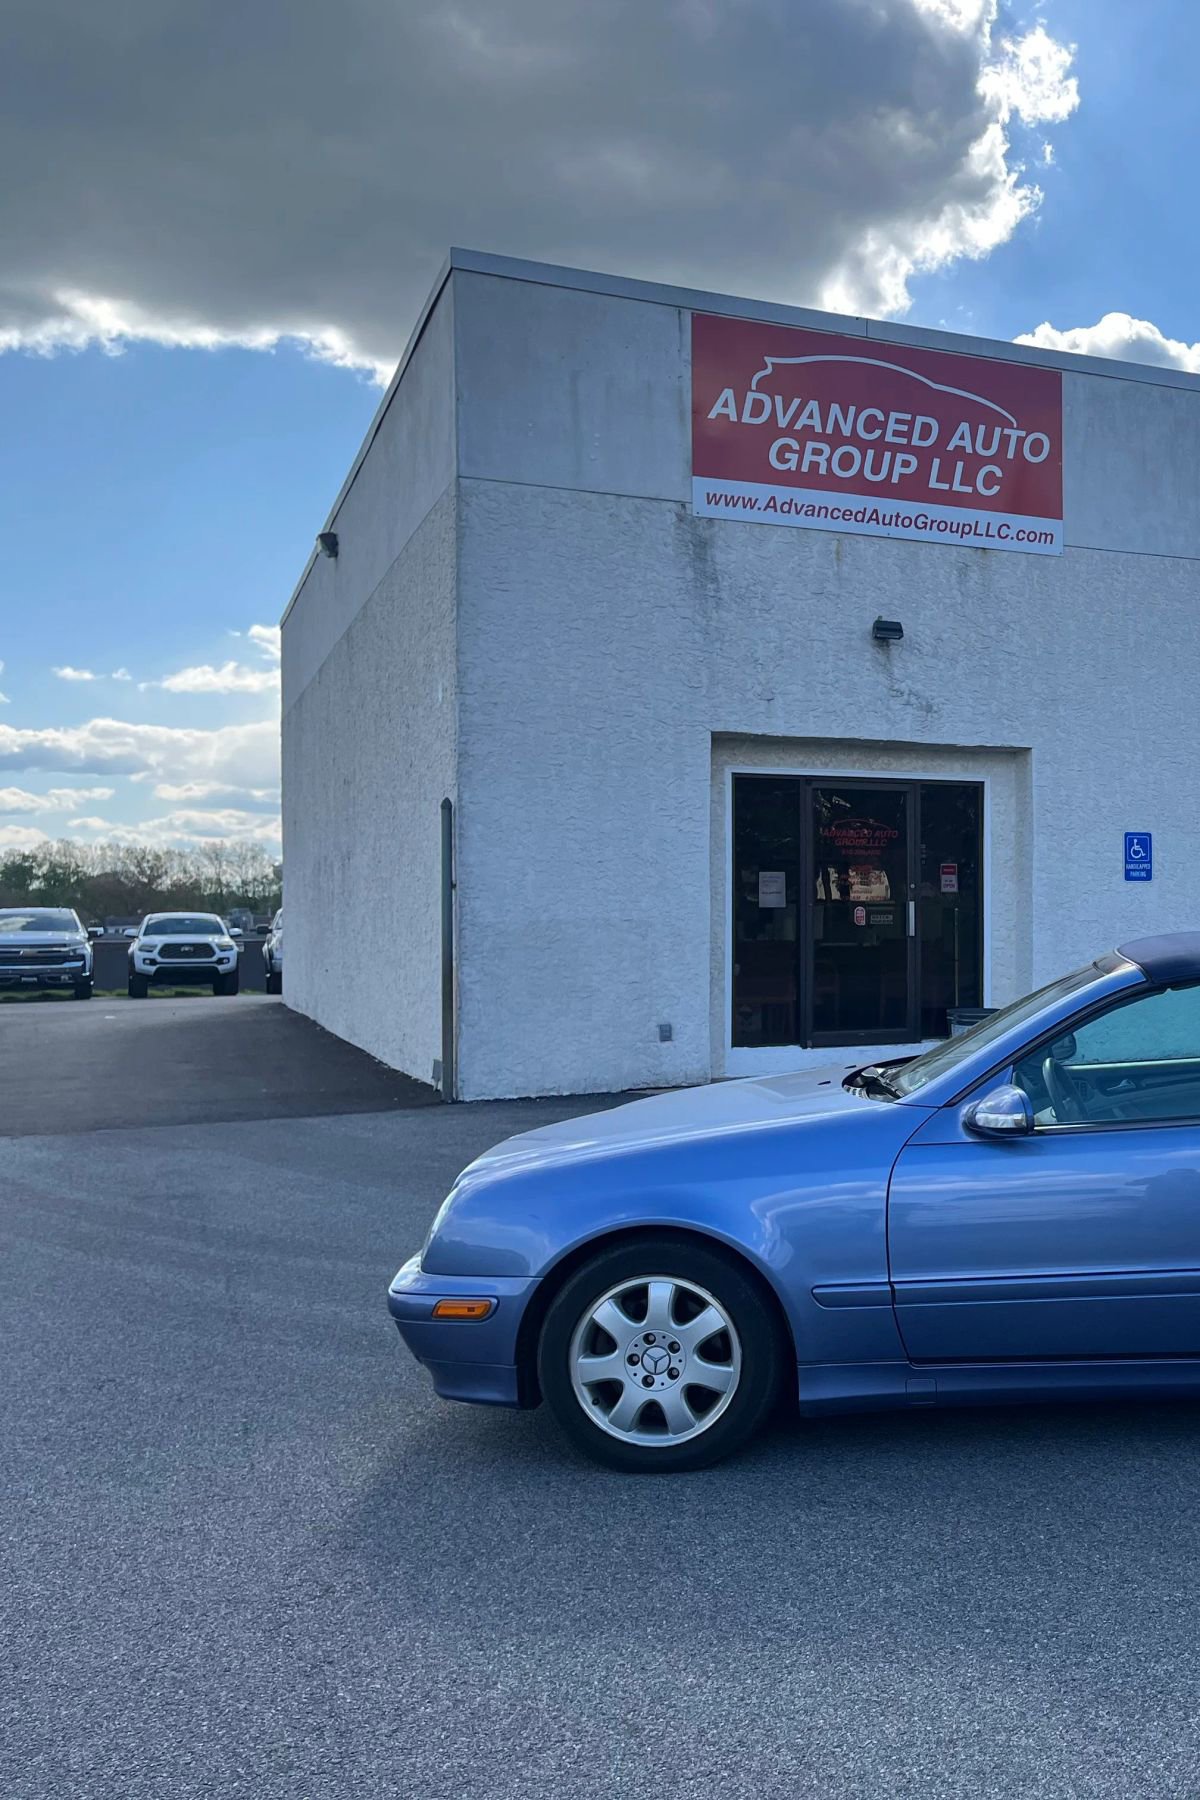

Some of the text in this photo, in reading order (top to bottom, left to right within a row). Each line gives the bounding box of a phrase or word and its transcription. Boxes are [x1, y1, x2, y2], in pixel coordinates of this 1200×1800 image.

[707, 387, 1051, 464] ADVANCED AUTO
[768, 437, 1003, 496] GROUP LLC
[705, 491, 1055, 545] www.AdvancedAutoGroupLLC.com
